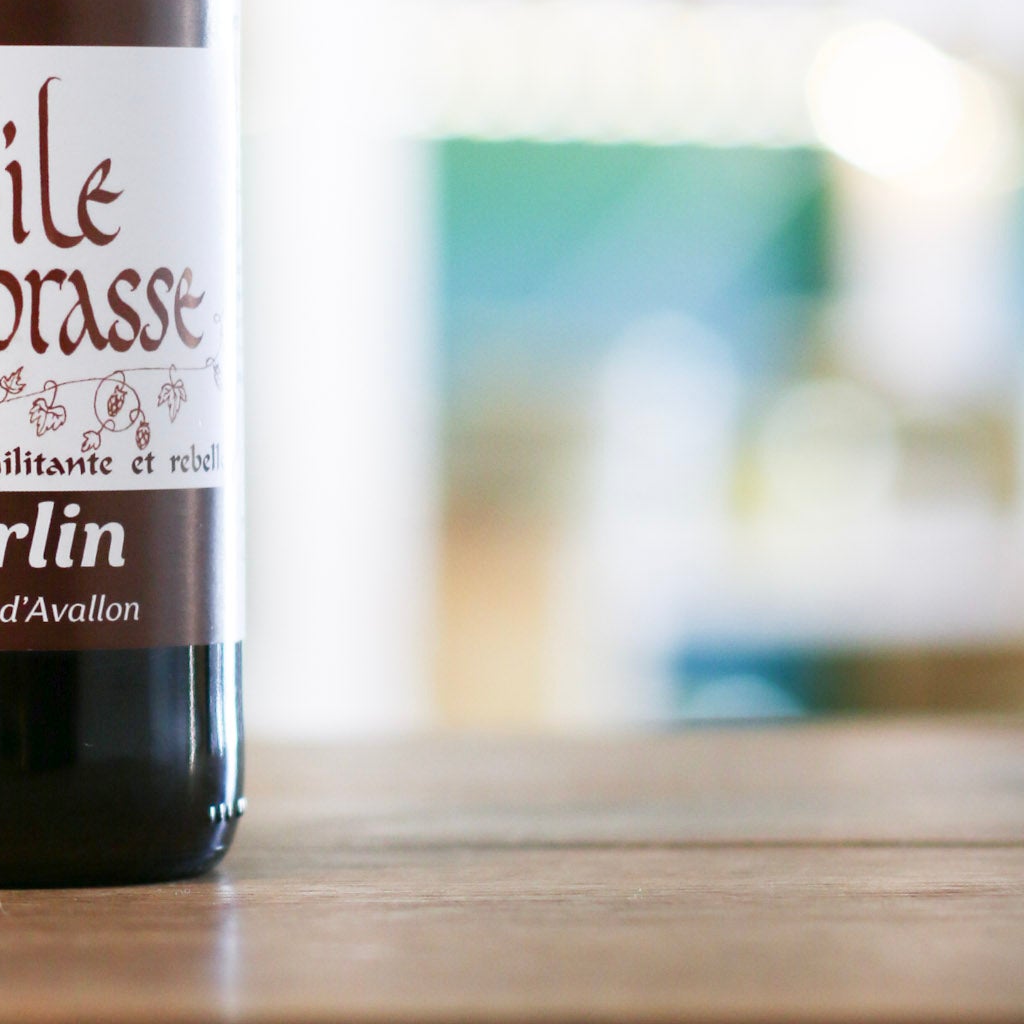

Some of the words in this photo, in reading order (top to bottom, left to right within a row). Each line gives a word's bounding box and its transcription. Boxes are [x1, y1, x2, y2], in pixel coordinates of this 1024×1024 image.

[131, 450, 155, 474] et
[170, 443, 223, 473] rebell
[0, 594, 140, 623] d’Avallon
